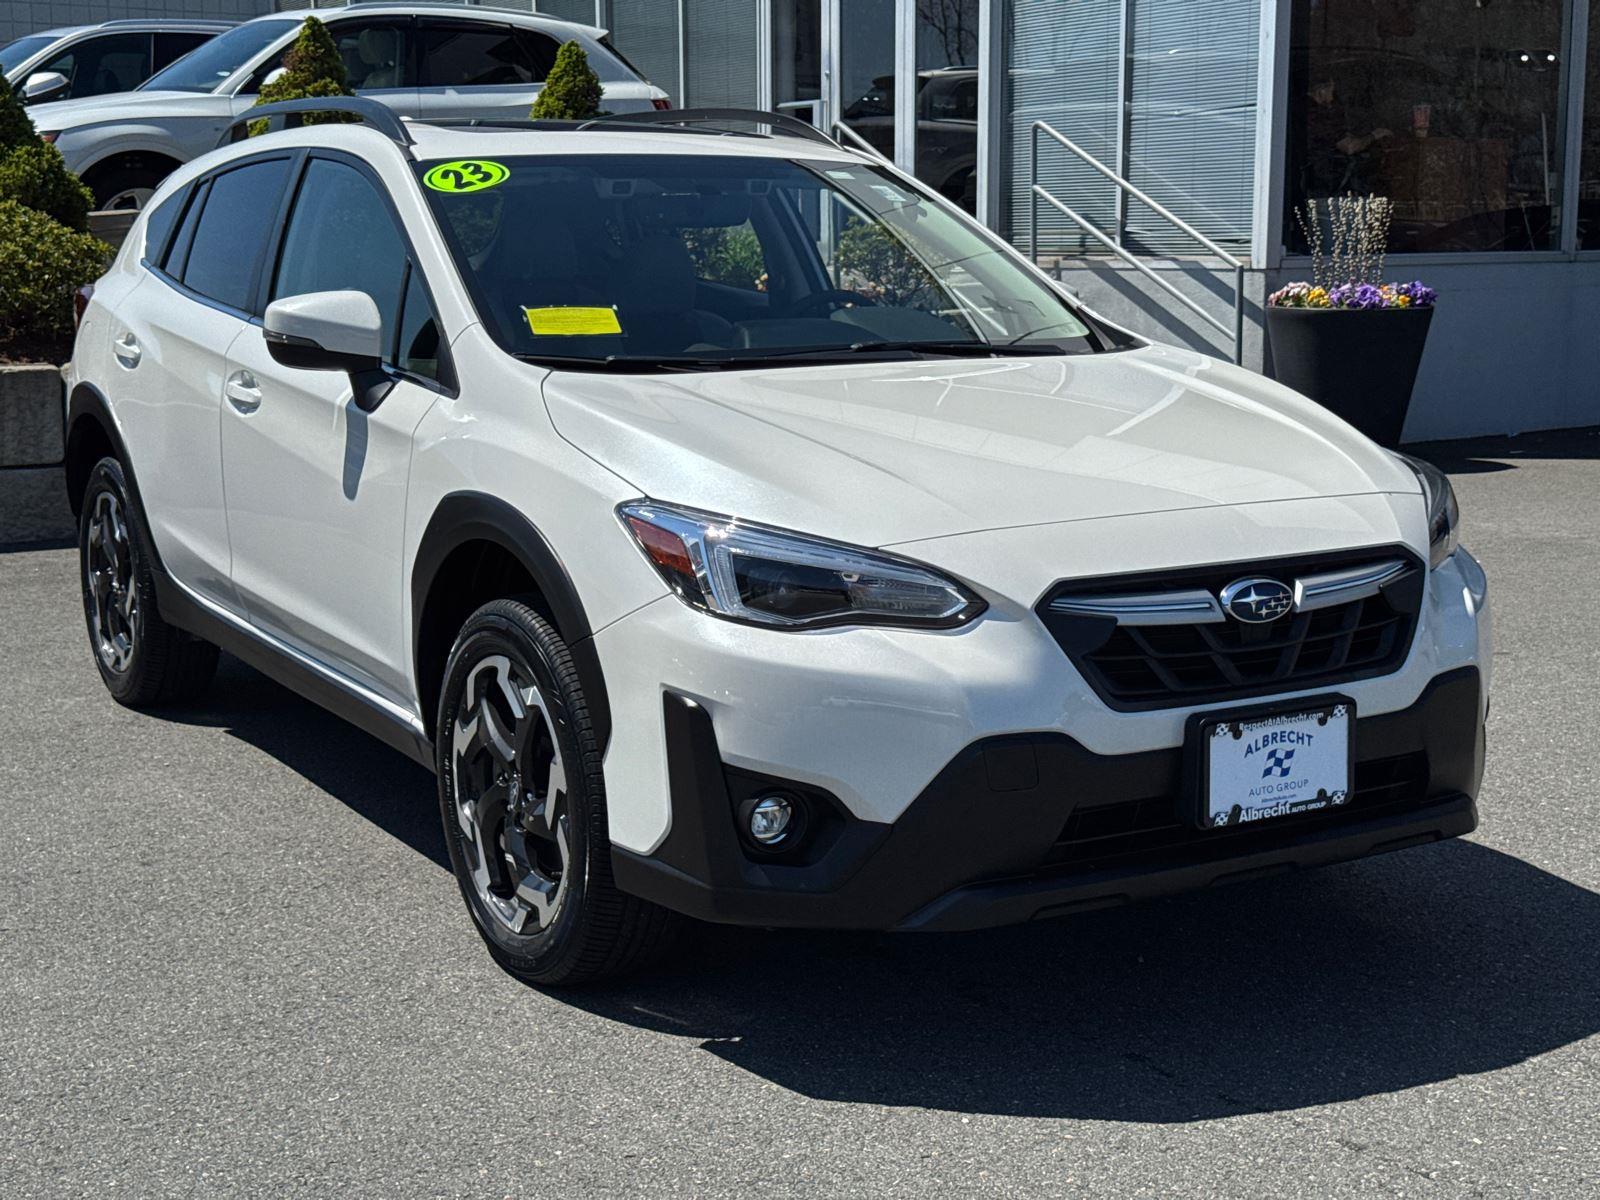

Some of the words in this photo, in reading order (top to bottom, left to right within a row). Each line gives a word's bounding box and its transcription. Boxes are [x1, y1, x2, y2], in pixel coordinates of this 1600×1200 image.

[441, 162, 493, 189] 23
[1244, 730, 1314, 758] ALBRECHT
[1248, 785, 1274, 797] AUTO
[1276, 779, 1309, 792] GROUP
[1239, 801, 1291, 823] Albrecht
[1291, 805, 1306, 813] AUTO
[1307, 801, 1327, 810] GROUP
